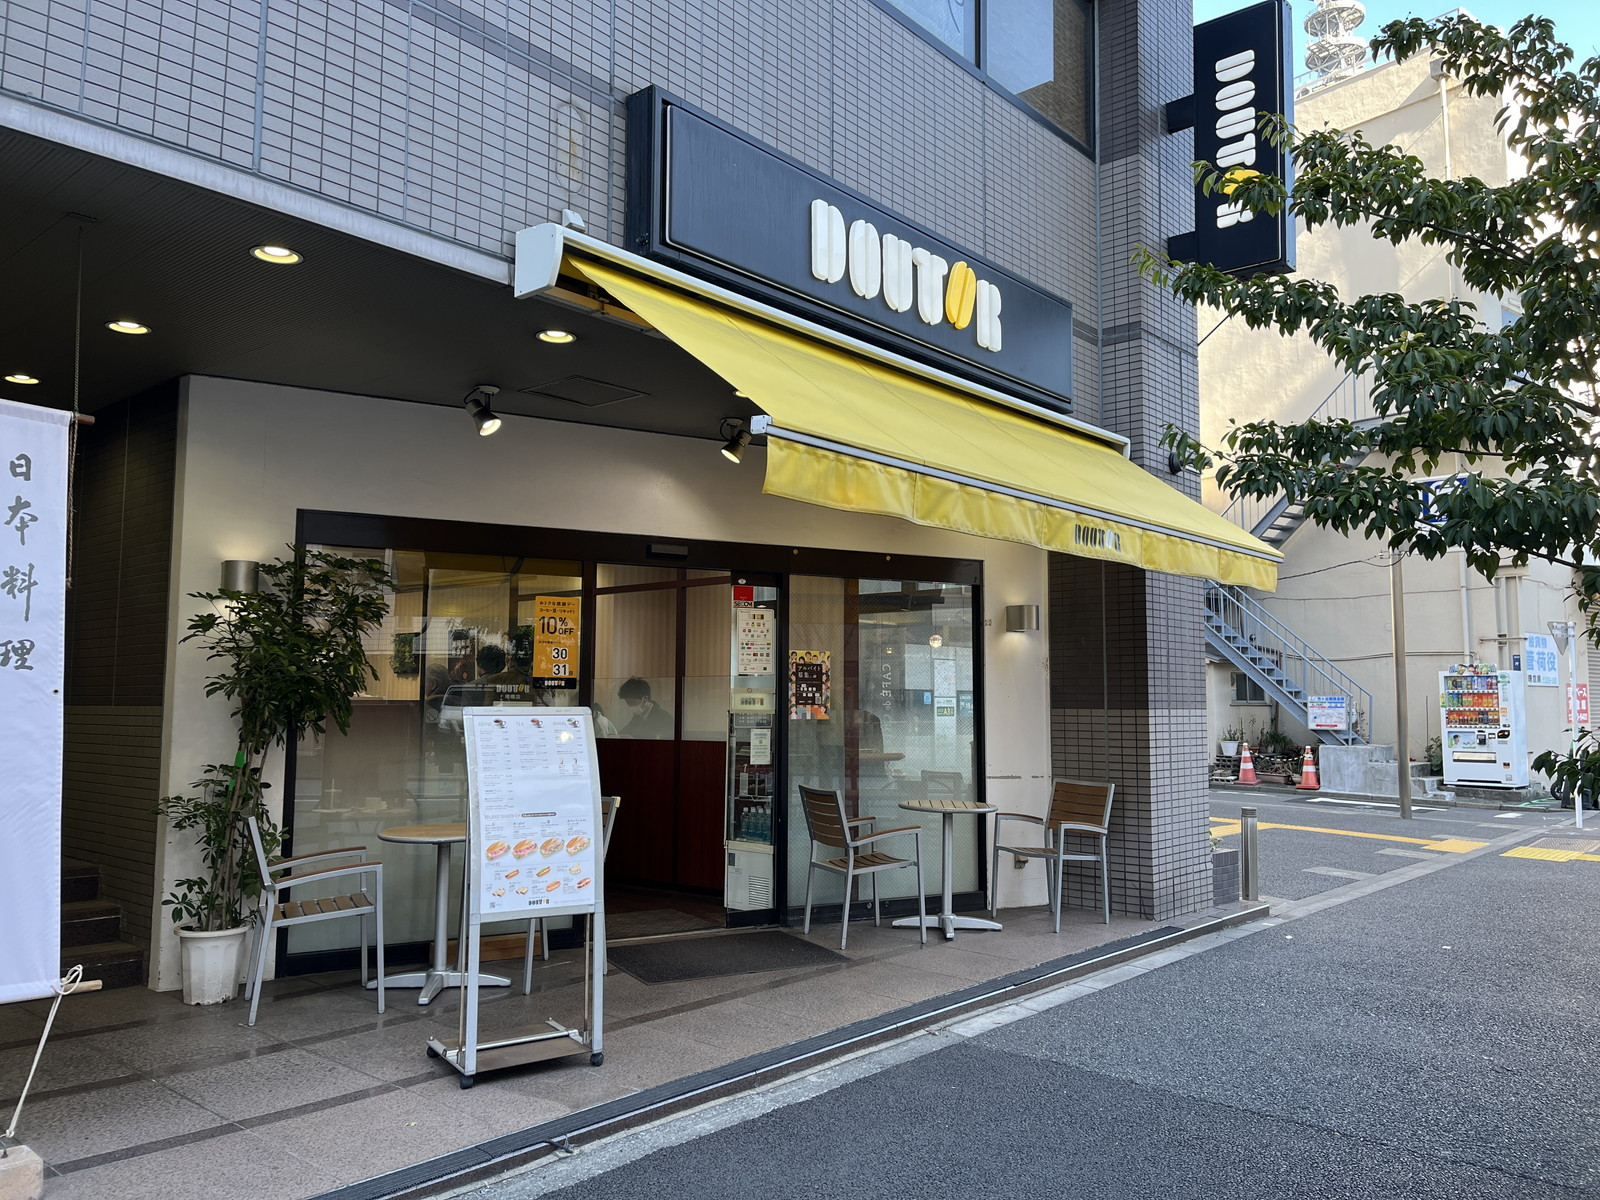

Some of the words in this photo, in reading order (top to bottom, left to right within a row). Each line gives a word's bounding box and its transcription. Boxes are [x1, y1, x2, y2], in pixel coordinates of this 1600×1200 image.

[811, 199, 1002, 352] DOUTOR
[1075, 523, 1121, 552] DOUTOR
[0, 453, 39, 671] 日本料理
[558, 627, 575, 635] OFF
[552, 648, 568, 660] 30
[553, 664, 568, 676] 31
[496, 684, 530, 693] DOUTOR
